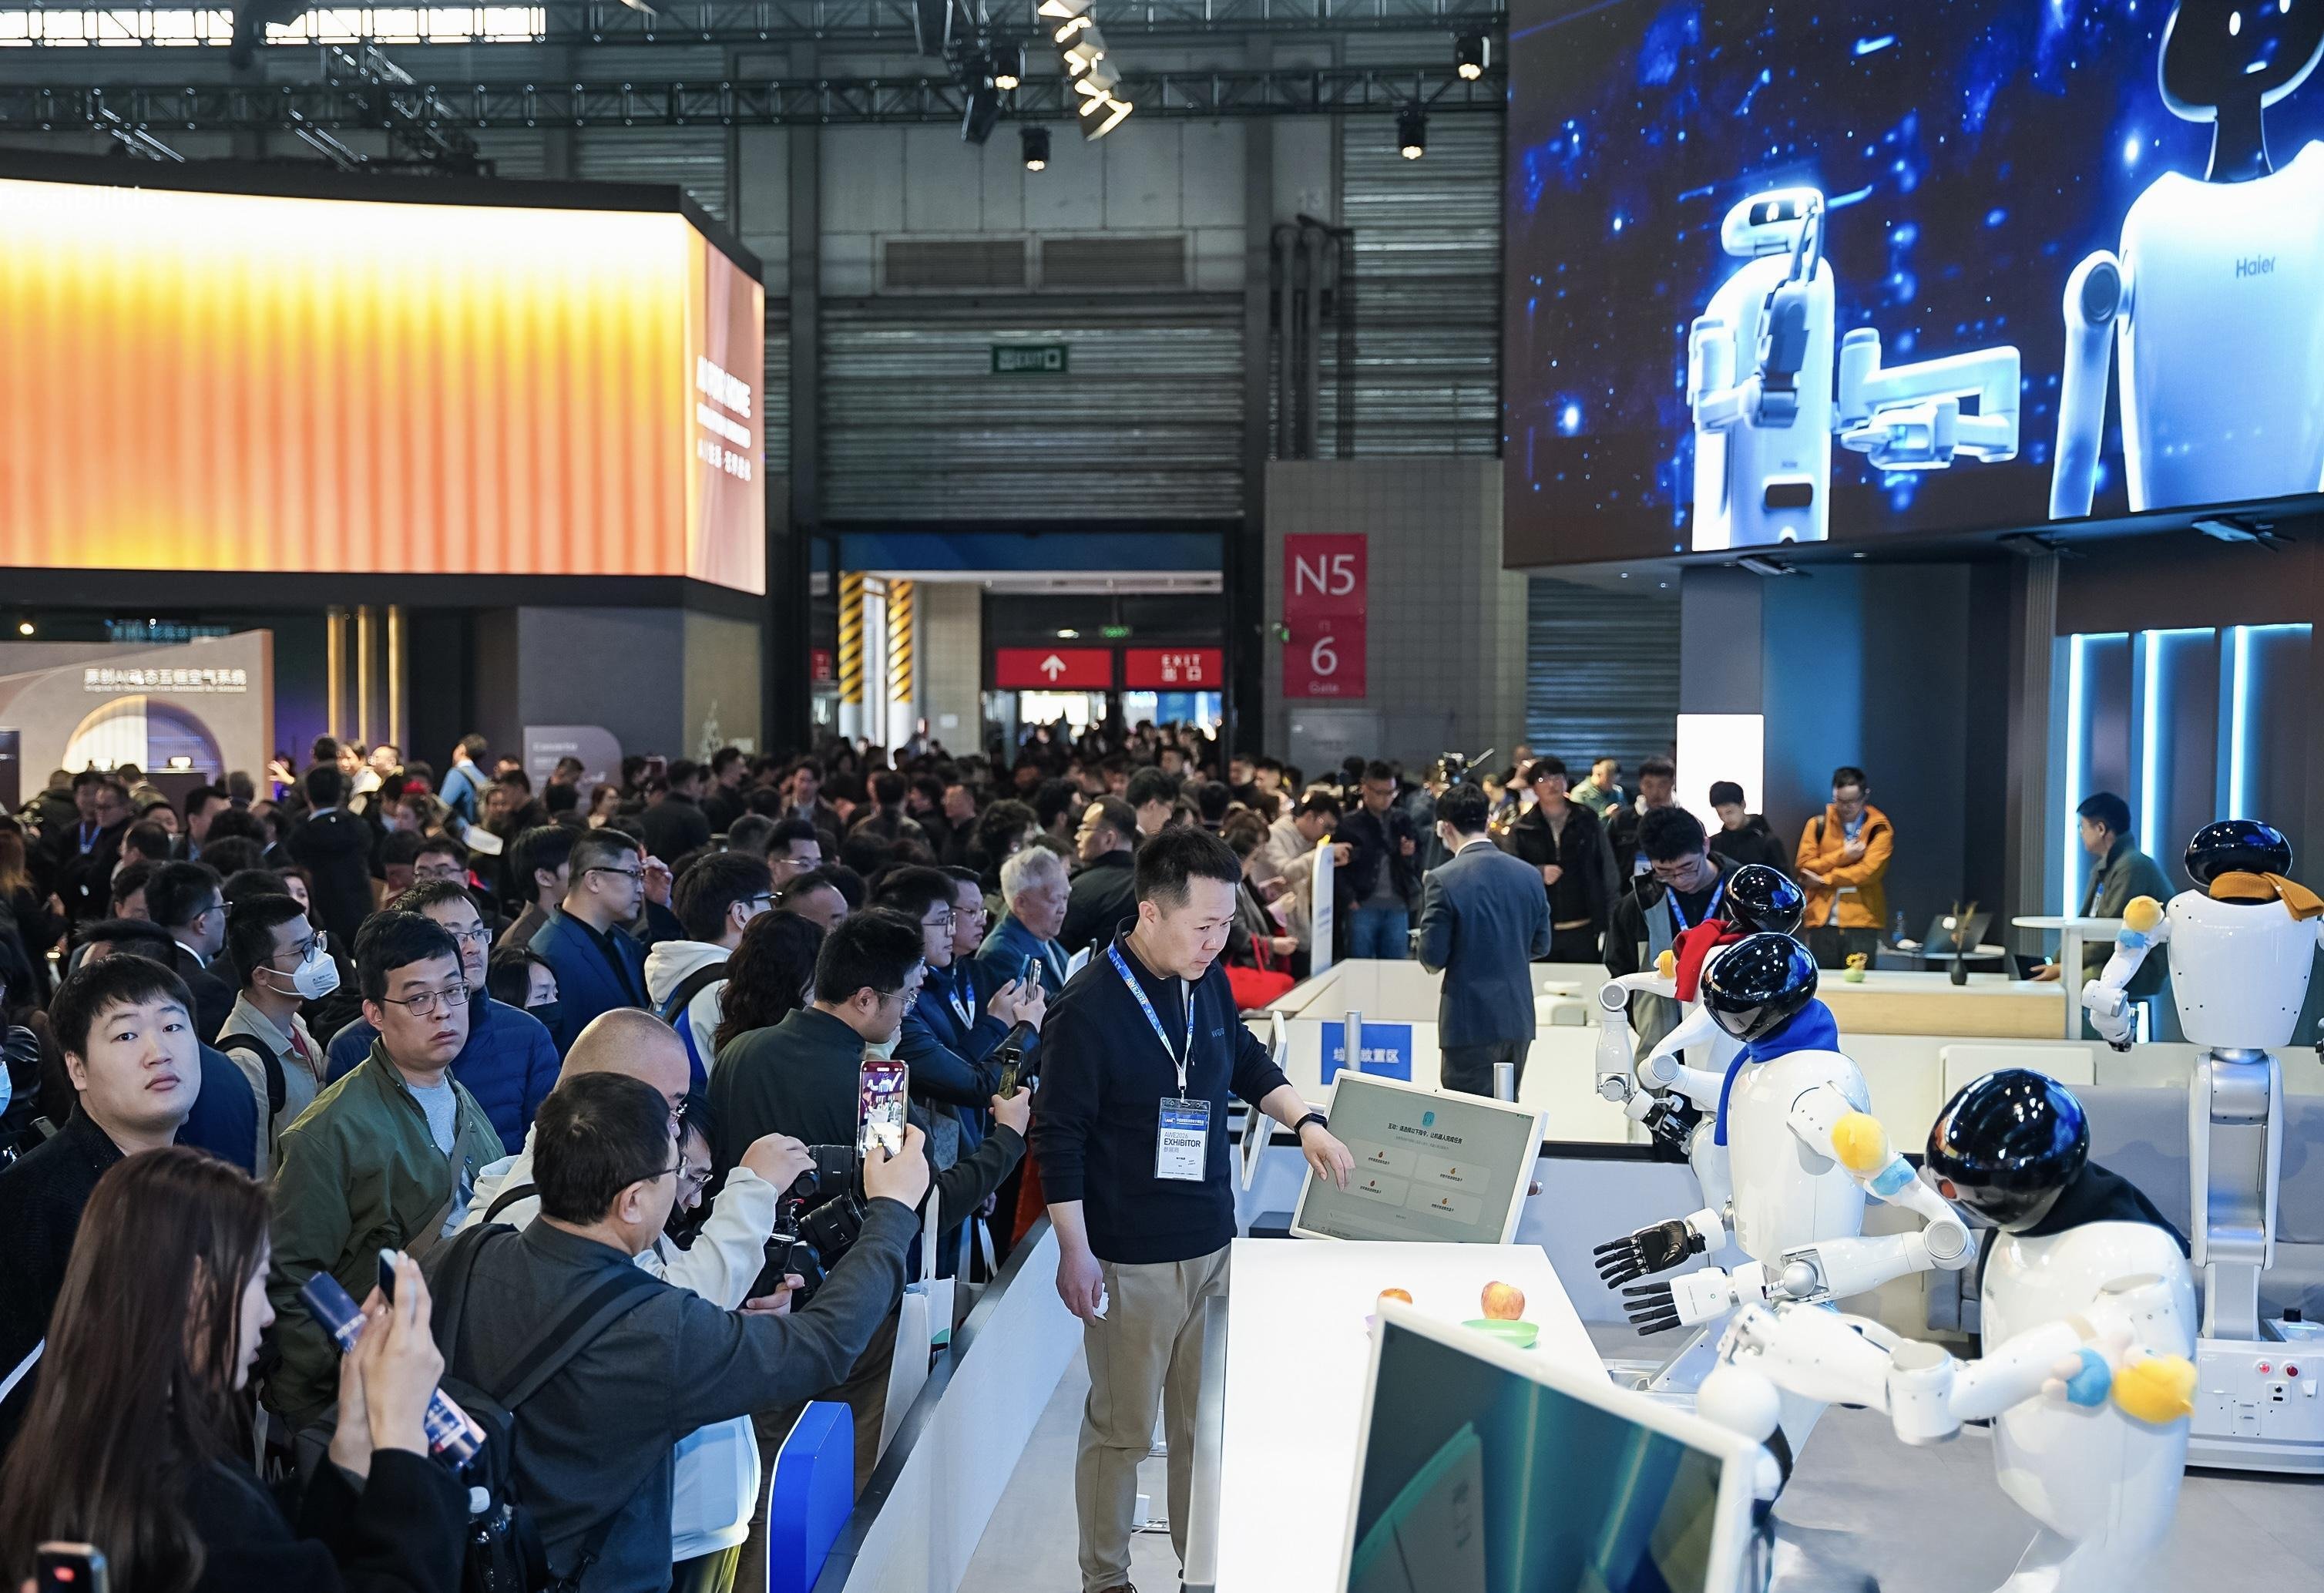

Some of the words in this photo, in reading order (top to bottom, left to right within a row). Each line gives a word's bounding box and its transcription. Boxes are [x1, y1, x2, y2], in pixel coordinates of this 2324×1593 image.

[2236, 254, 2275, 279] Haier
[1295, 554, 1356, 596] N5
[1161, 654, 1202, 667] EXIT
[1311, 636, 1338, 676] 6
[1126, 977, 1147, 1006] AWE2026
[1164, 1138, 1201, 1148] EXHIBITOR
